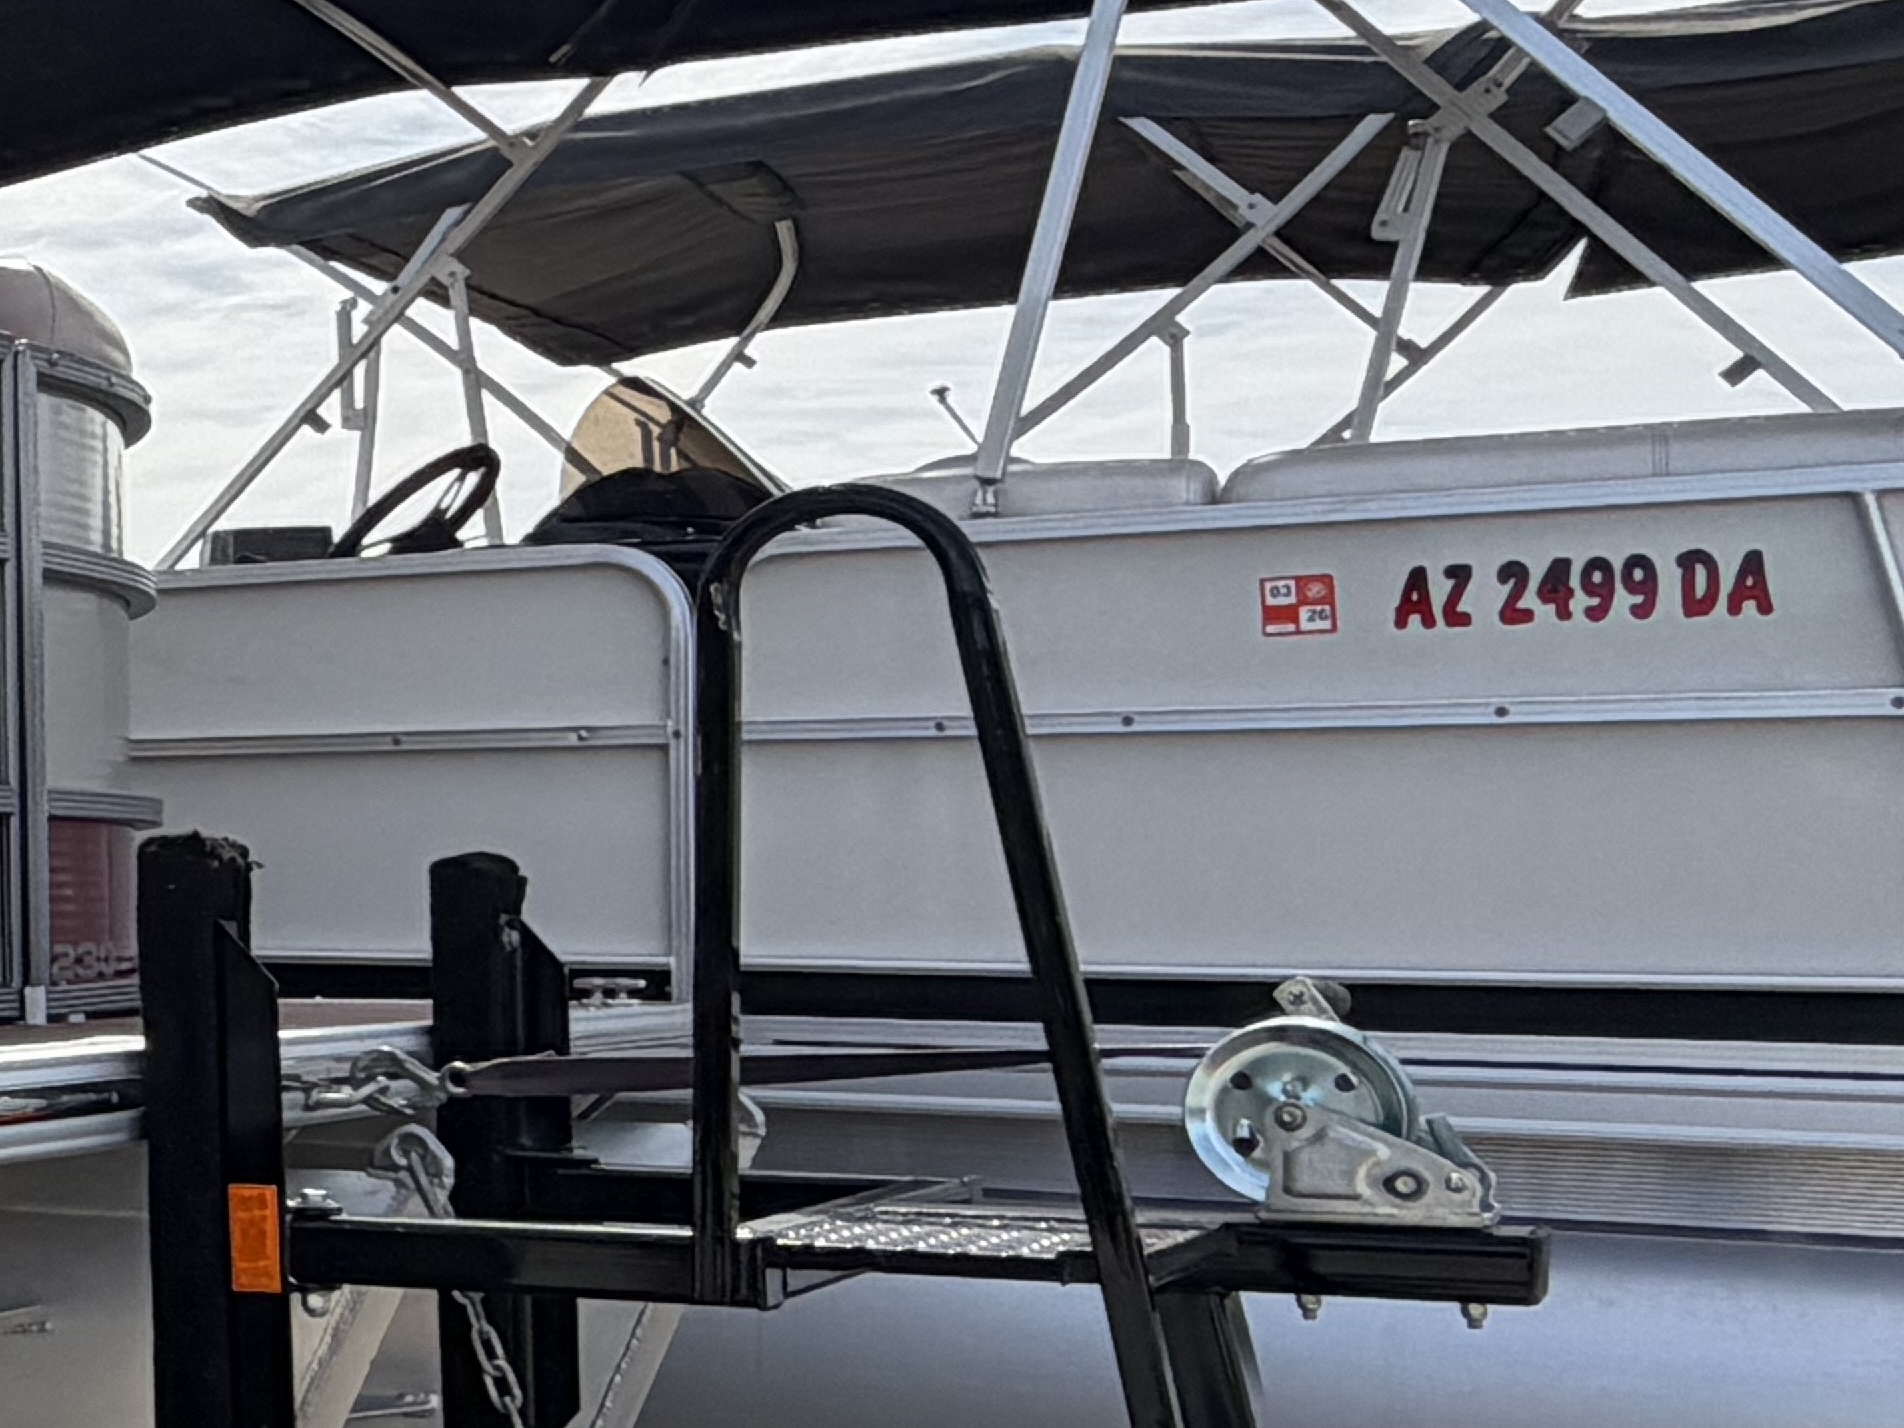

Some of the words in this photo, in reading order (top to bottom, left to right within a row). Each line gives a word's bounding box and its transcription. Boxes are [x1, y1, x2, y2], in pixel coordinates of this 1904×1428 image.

[1394, 565, 1473, 629] AZ
[1496, 552, 1658, 625] 2499
[1675, 548, 1774, 618] DA
